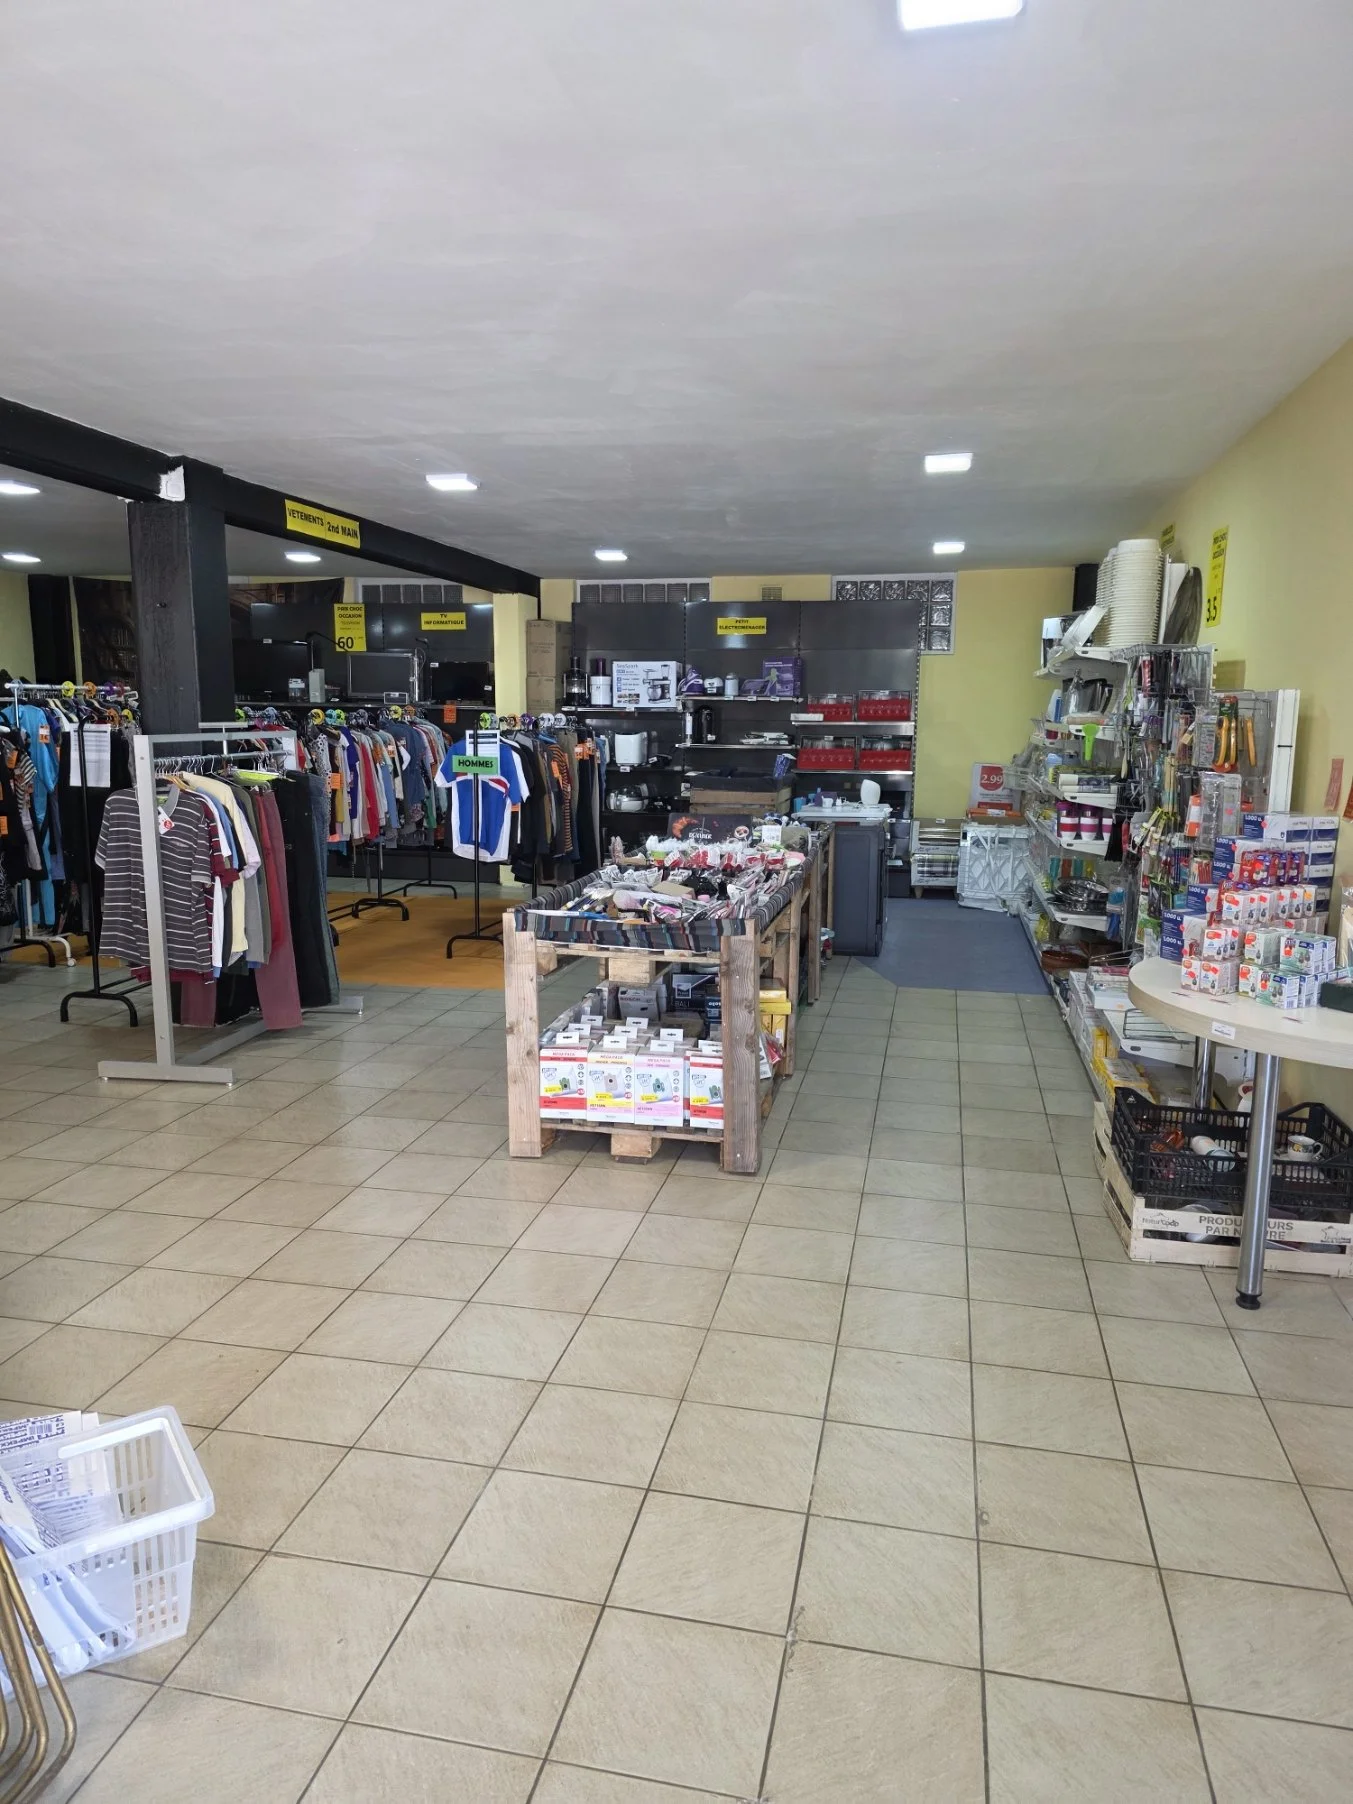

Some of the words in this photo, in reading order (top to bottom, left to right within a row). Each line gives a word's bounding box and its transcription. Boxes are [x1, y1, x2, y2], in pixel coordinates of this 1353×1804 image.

[287, 508, 324, 526] VETEMENTS
[327, 522, 339, 533] 2nd
[341, 525, 358, 539] MAIN
[458, 759, 494, 768] HOMMES
[981, 774, 1003, 785] 2.99
[1205, 1225, 1230, 1236] PAR
